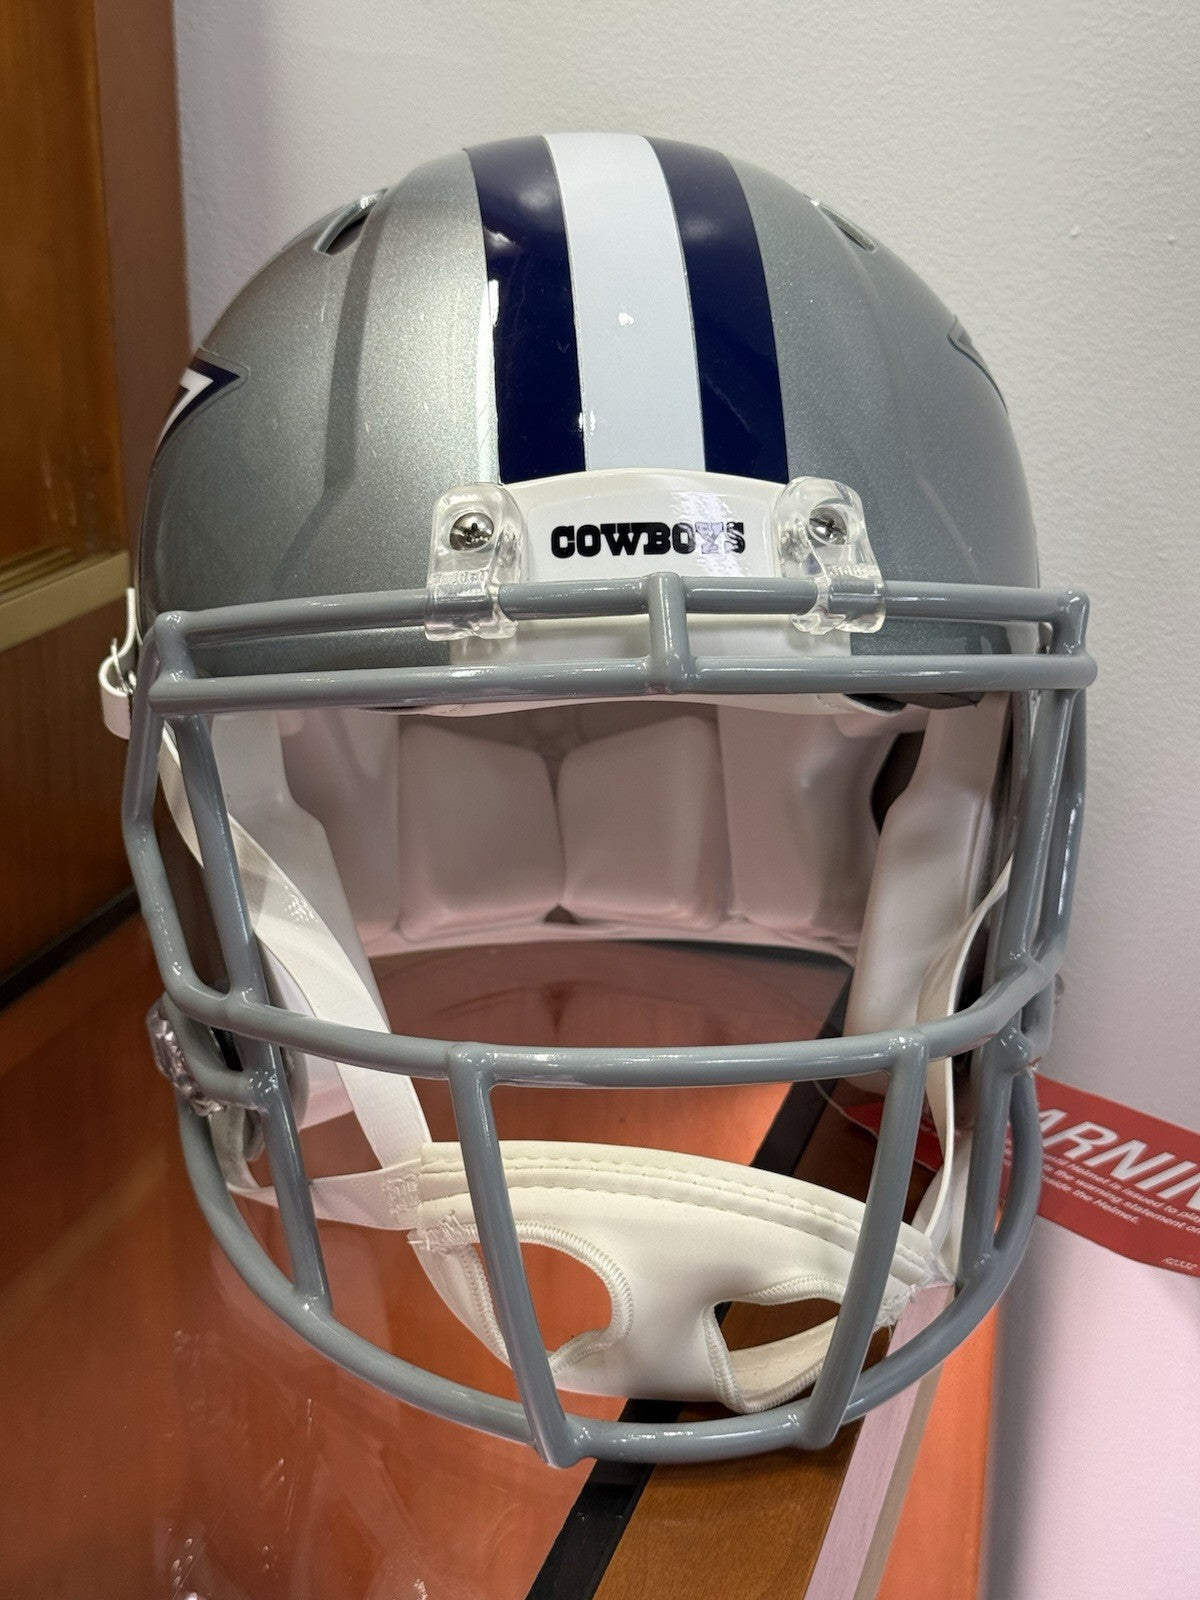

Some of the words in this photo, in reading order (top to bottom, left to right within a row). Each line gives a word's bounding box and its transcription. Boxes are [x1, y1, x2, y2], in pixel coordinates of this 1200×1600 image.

[551, 522, 746, 558] COWBOYS
[1072, 1190, 1094, 1203] the
[1075, 1177, 1125, 1204] warning
[1122, 1200, 1187, 1229] statement
[1122, 1188, 1165, 1208] issued
[1163, 1204, 1179, 1215] to
